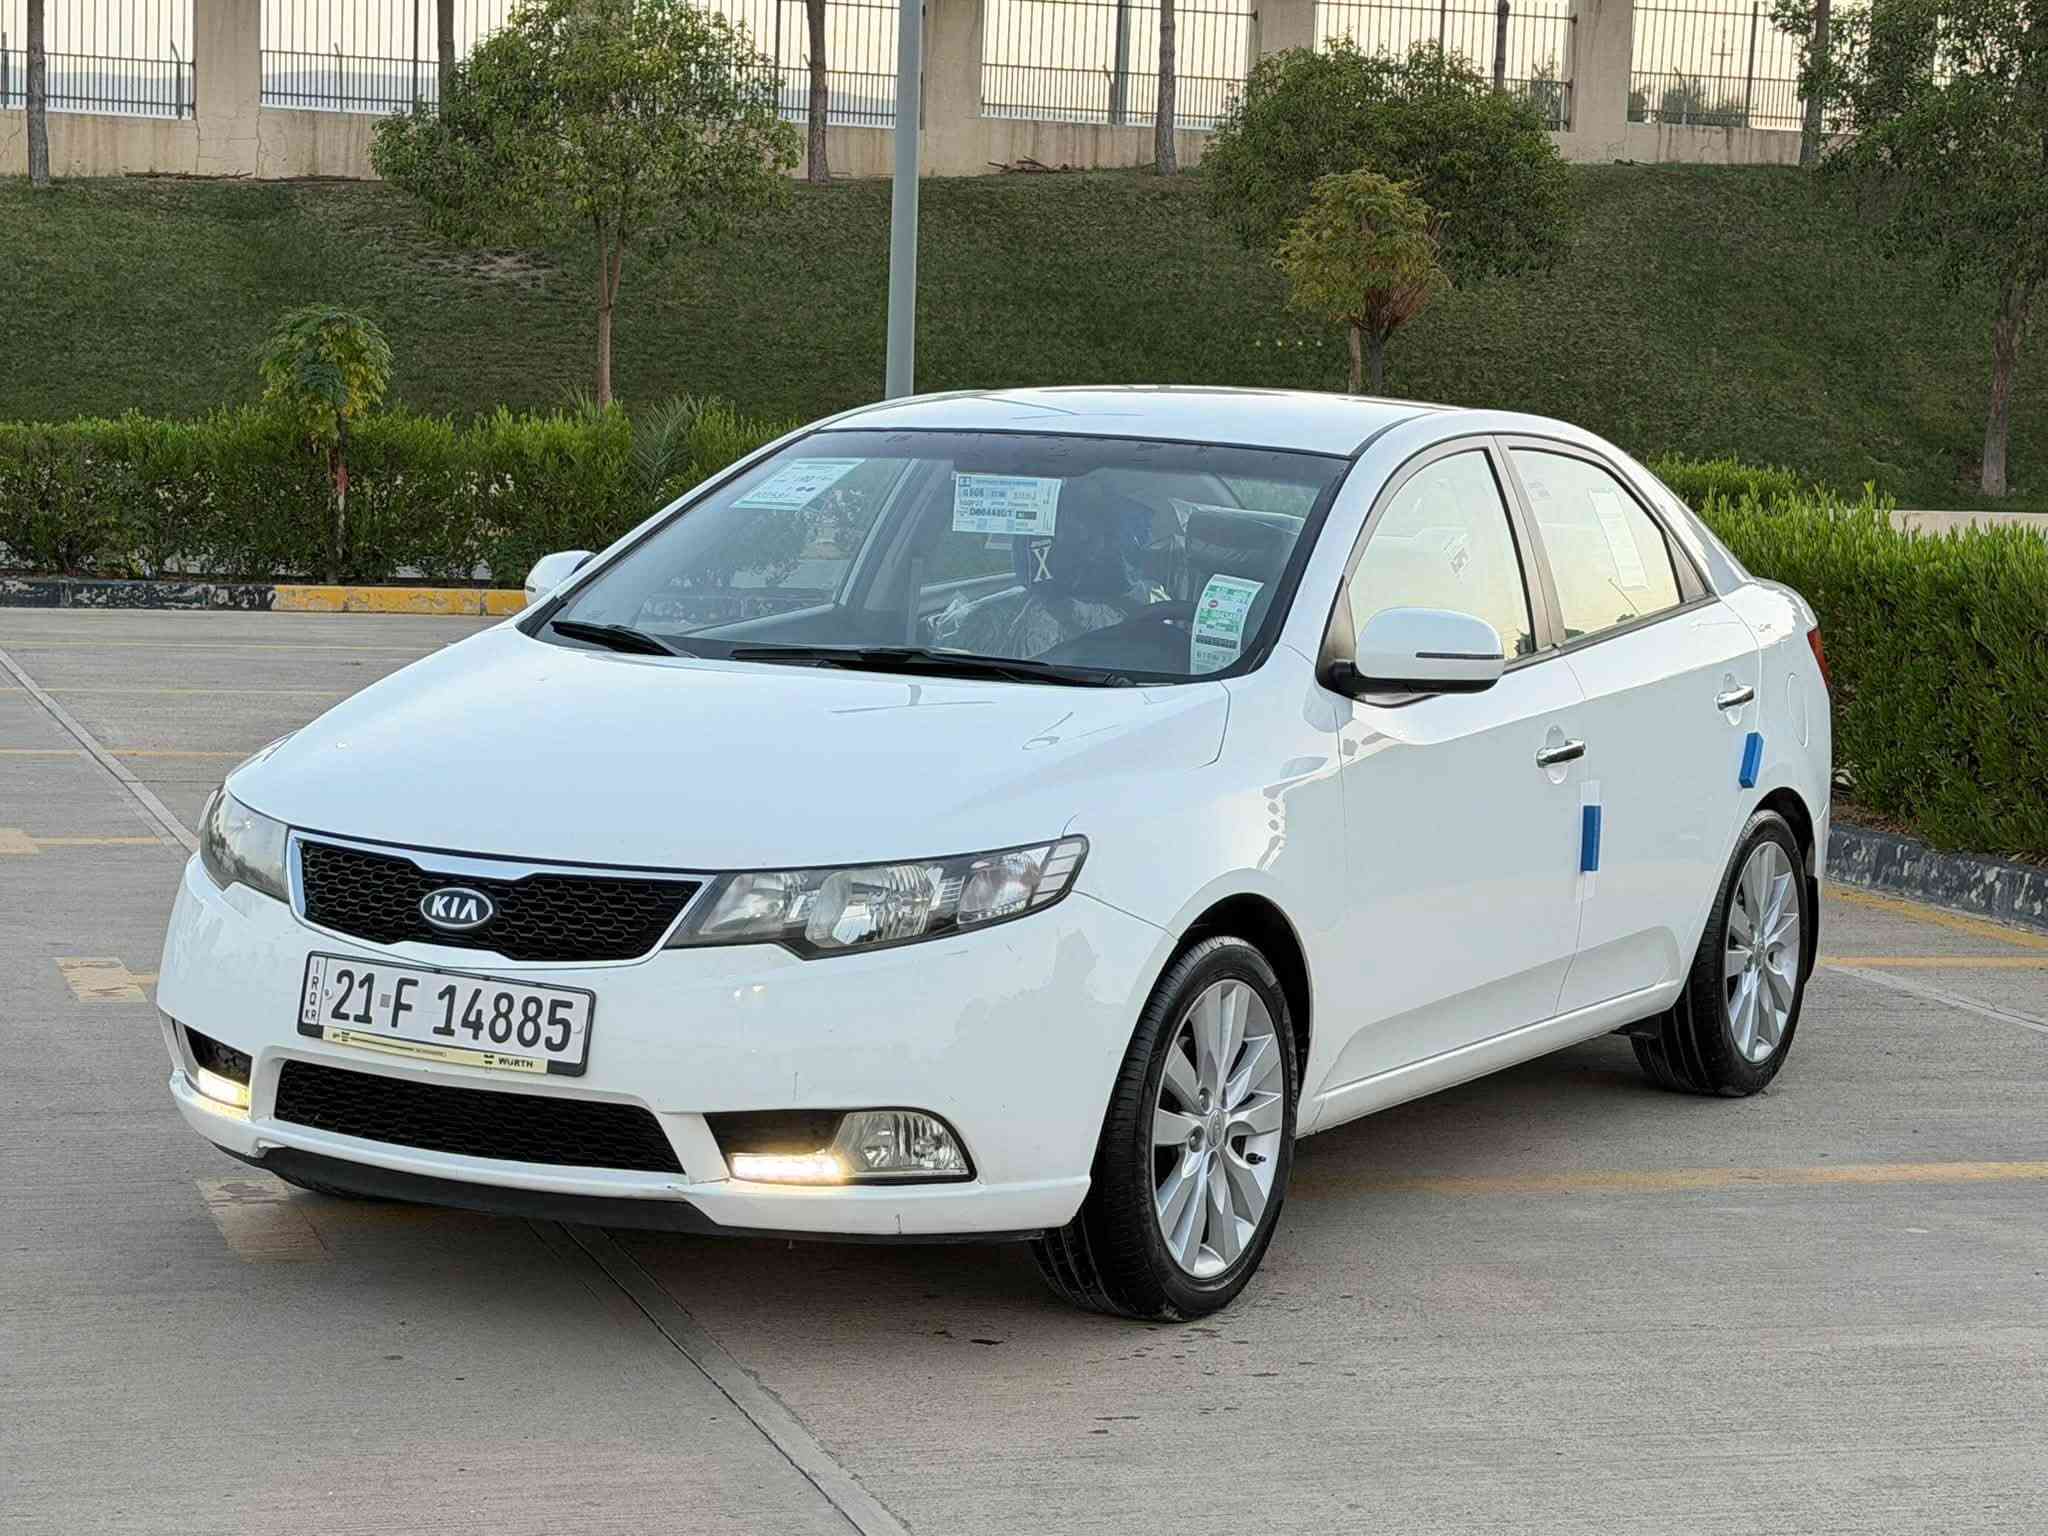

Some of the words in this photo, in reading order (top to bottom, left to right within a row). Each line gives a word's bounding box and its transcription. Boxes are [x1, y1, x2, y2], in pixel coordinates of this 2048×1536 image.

[430, 894, 479, 921] KIA
[331, 968, 375, 1025] 21
[390, 976, 420, 1028] F
[432, 984, 575, 1052] 14885
